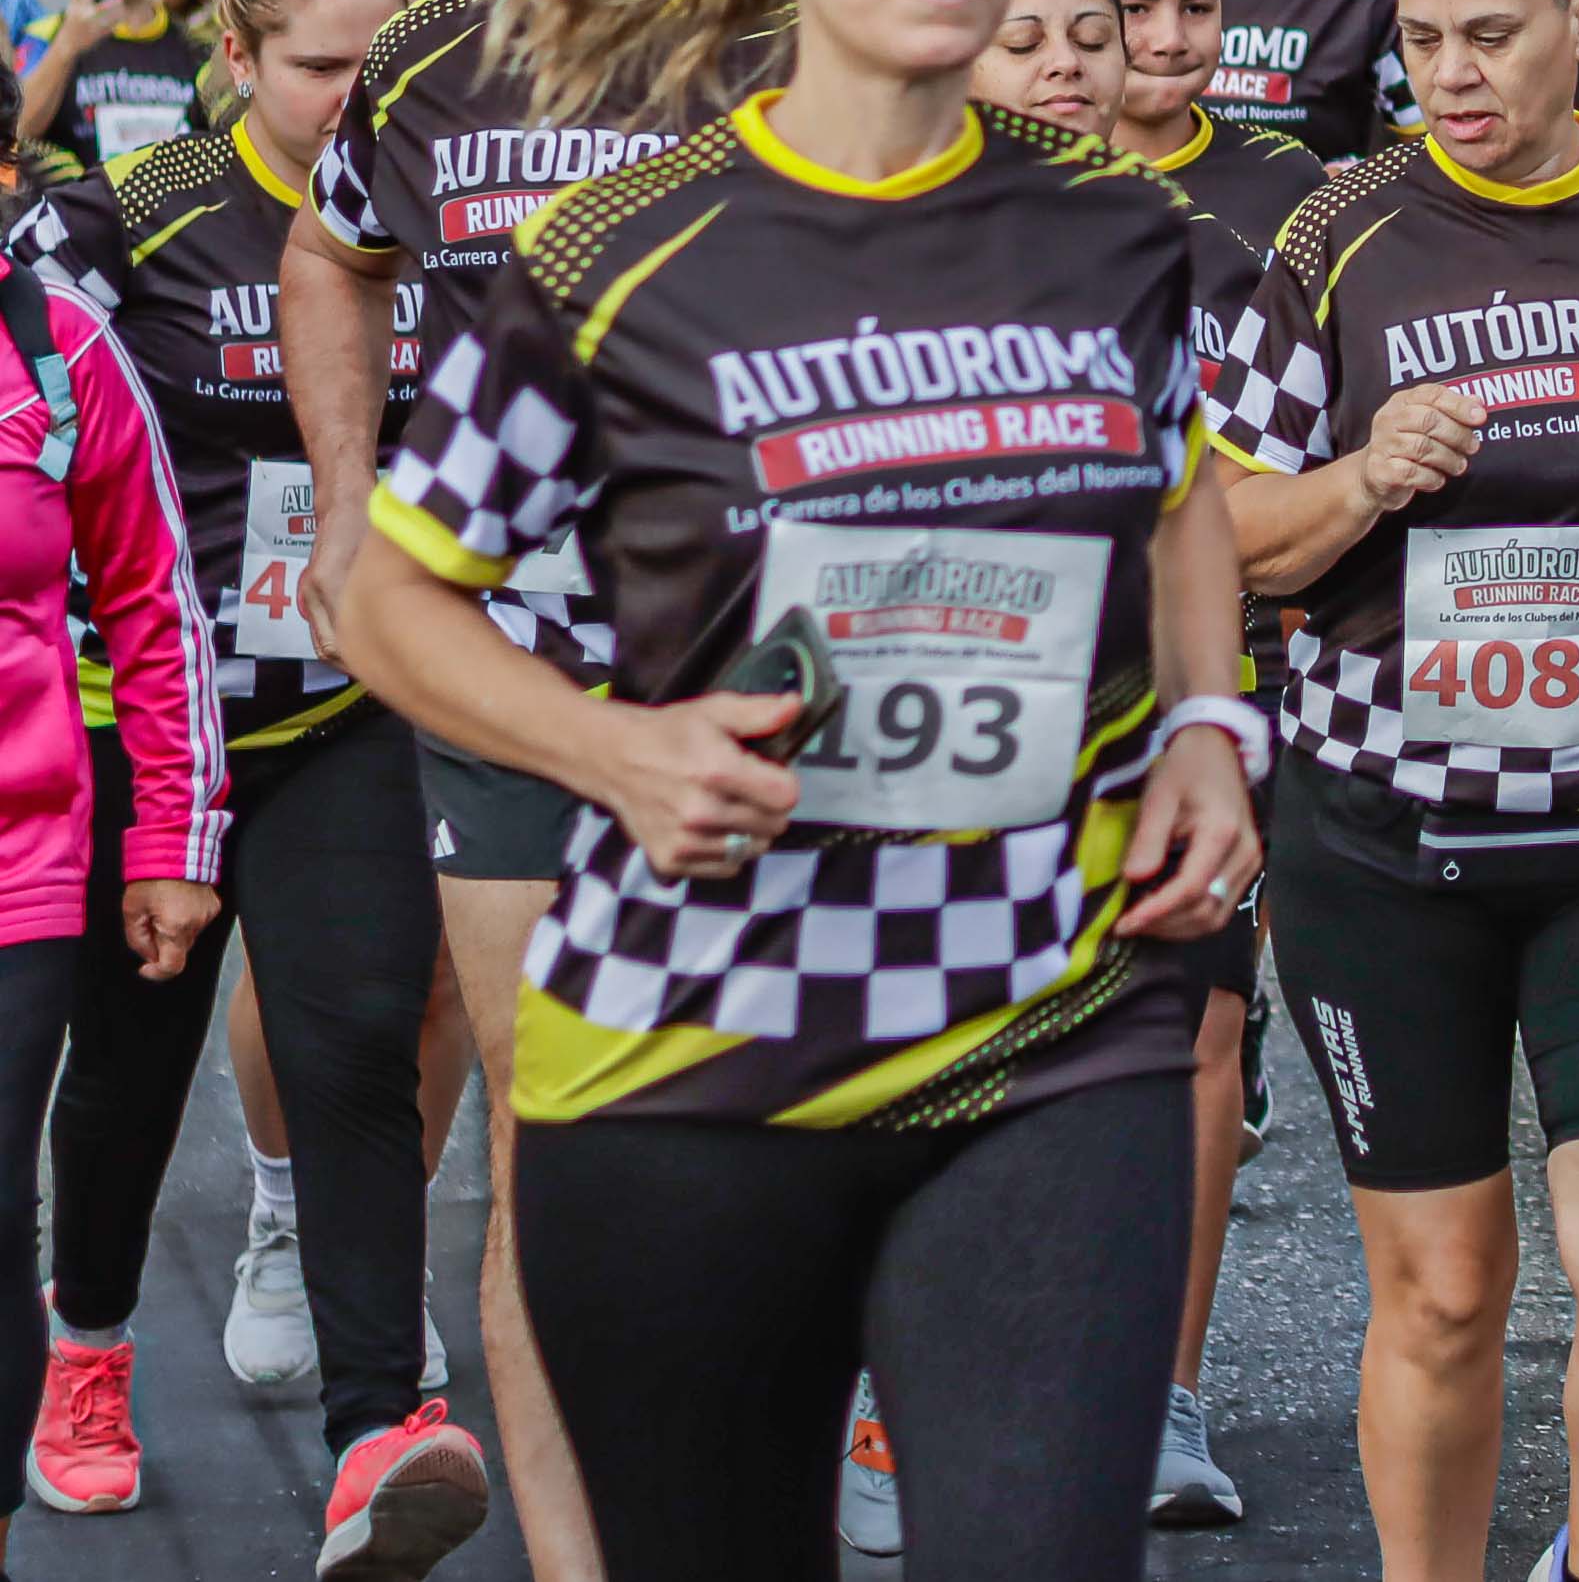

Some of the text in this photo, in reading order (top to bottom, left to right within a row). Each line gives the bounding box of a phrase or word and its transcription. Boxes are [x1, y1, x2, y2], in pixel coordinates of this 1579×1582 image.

[1209, 69, 1268, 100] RACE
[1224, 104, 1308, 121] del Noroeste
[423, 251, 438, 269] La
[440, 249, 497, 267] Carrera
[196, 377, 214, 394] La
[218, 382, 282, 402] Carrera
[709, 315, 1136, 436] AUTÓDROMO
[797, 403, 1109, 477] RUNNING RACE
[1487, 422, 1511, 440] de
[1516, 419, 1542, 438] los
[727, 505, 759, 534] La
[865, 484, 900, 514] de
[902, 482, 942, 510] los
[944, 473, 1035, 506] Clubes
[1037, 463, 1082, 496] del
[1471, 585, 1544, 606] RUNNING
[1440, 613, 1450, 623] La
[1453, 613, 1489, 624] Carrera
[1493, 612, 1505, 623] de
[1508, 612, 1522, 623] los
[1524, 612, 1557, 623] Clubes
[1560, 611, 1574, 622] del
[797, 682, 1022, 776] 193
[1337, 1008, 1375, 1109] RUNNING
